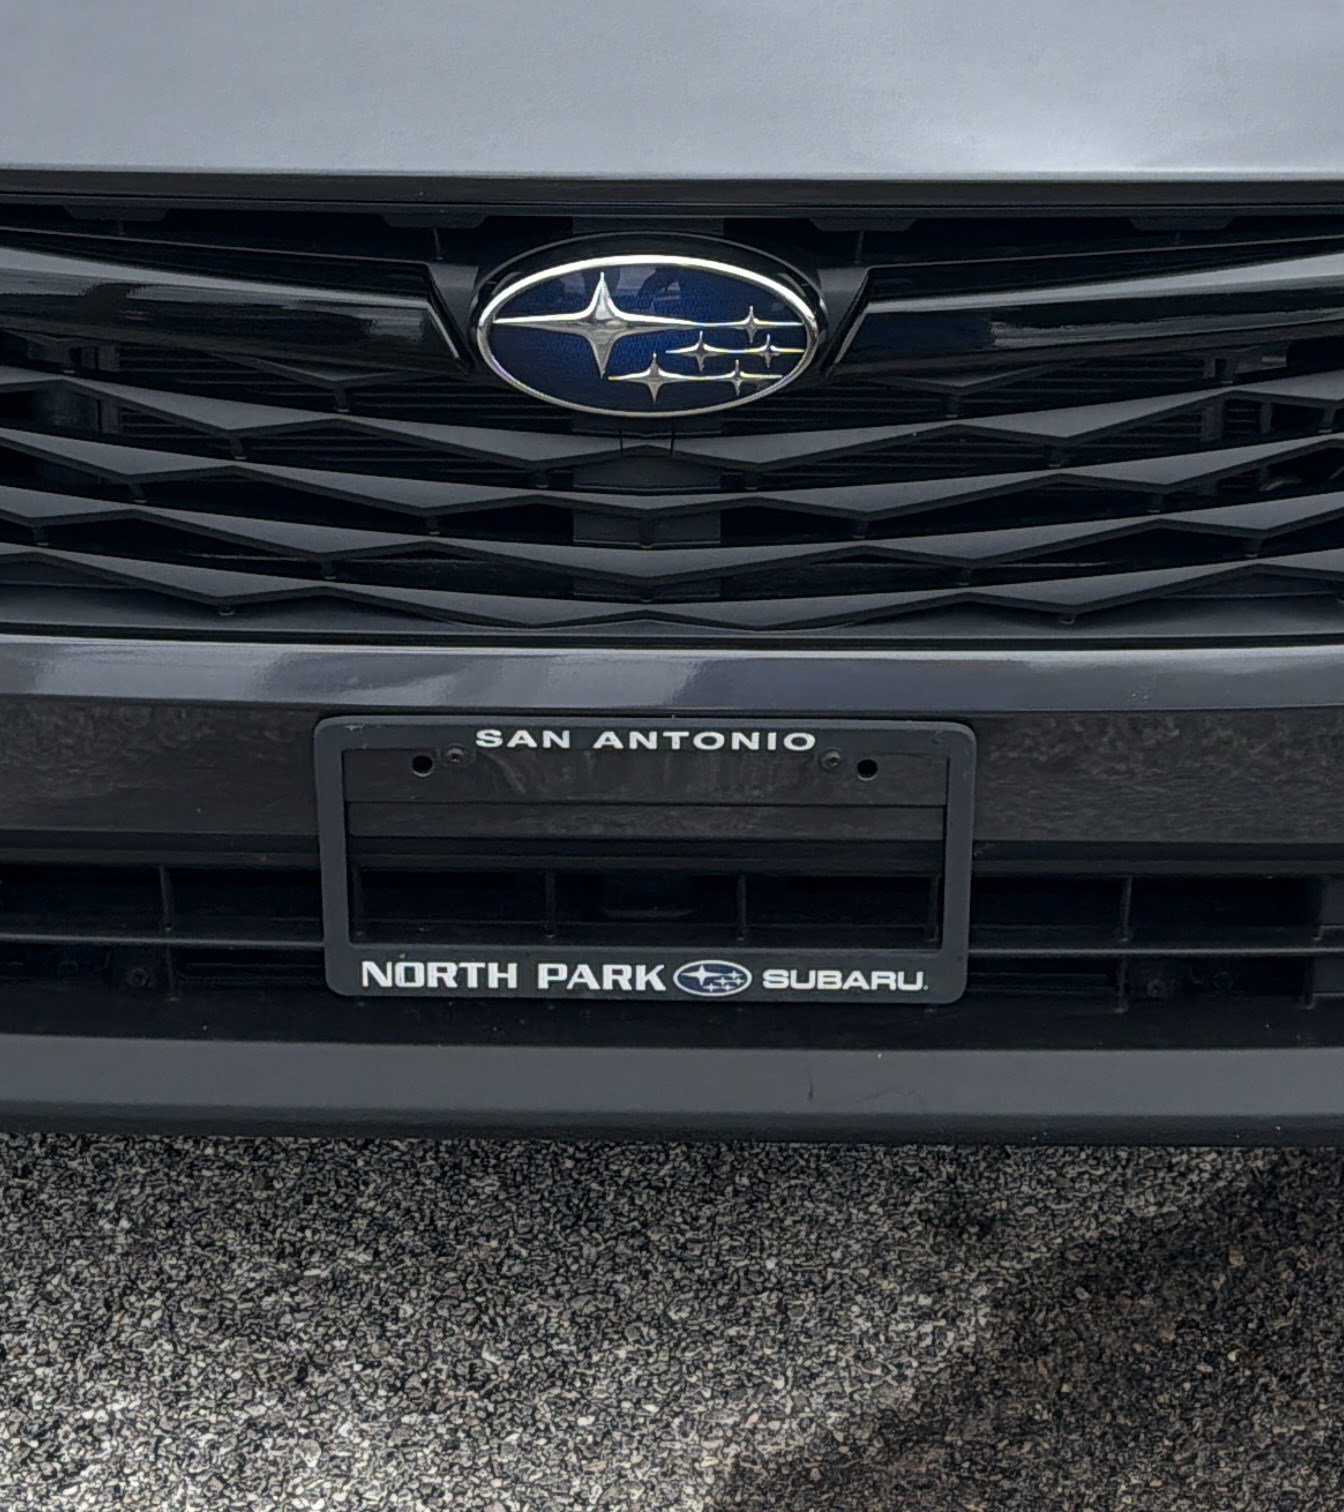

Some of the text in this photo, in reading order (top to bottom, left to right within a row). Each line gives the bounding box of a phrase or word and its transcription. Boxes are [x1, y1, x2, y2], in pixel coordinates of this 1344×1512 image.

[475, 728, 816, 752] SAN ANTONIO
[361, 960, 925, 991] NORTH PARK SUBARU
